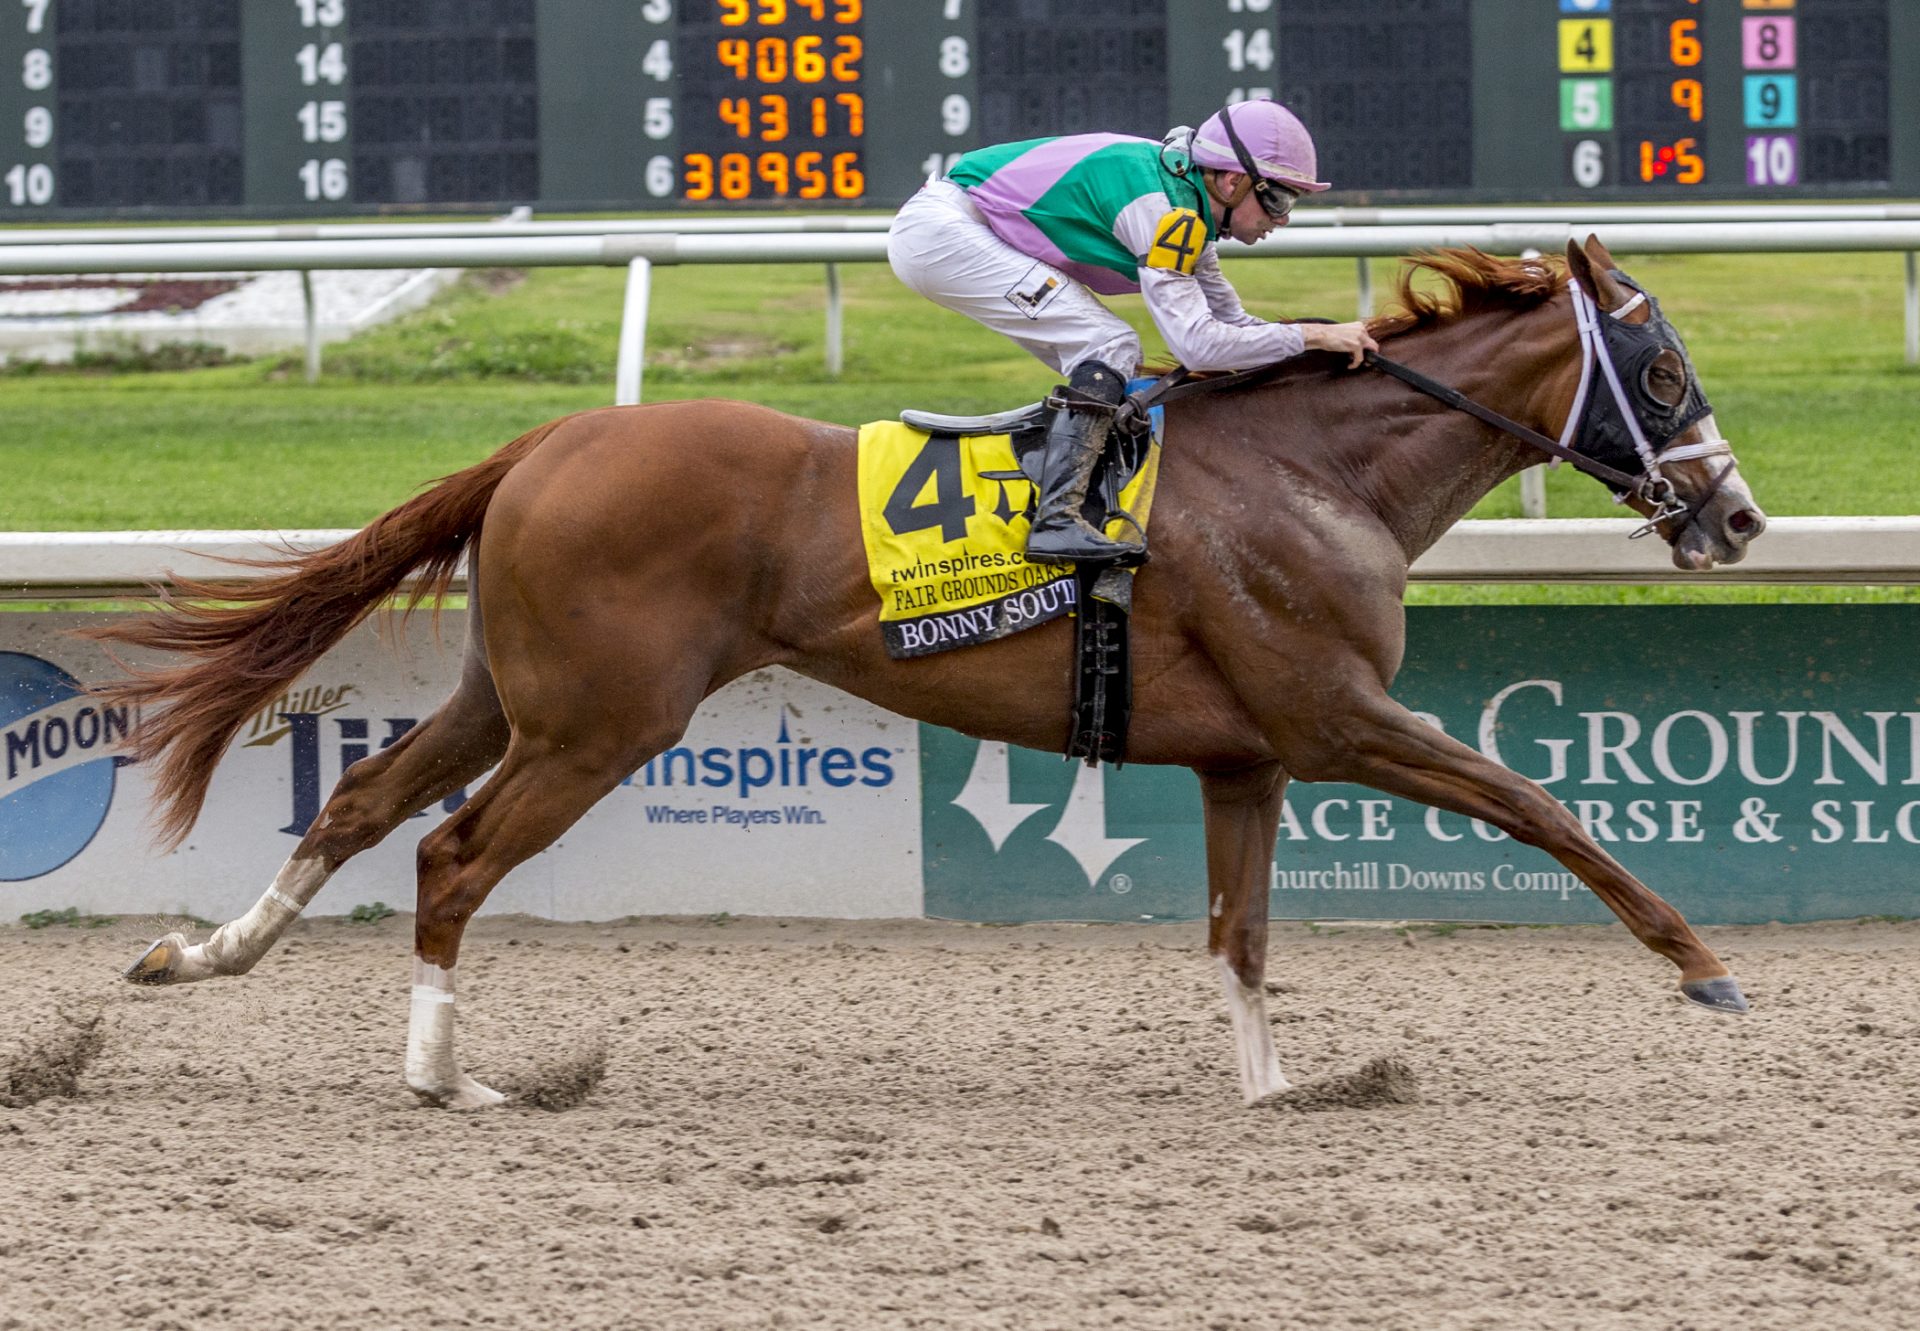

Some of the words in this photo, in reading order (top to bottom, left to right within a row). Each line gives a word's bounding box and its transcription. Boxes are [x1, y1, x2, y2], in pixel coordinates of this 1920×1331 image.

[643, 39, 673, 82] 4
[717, 35, 863, 83] 4062
[939, 35, 970, 79] 8
[1222, 28, 1275, 72] 14
[1574, 27, 1596, 64] 4
[1669, 18, 1702, 67] 6
[1758, 23, 1780, 61] 8
[23, 48, 52, 90] 8
[296, 43, 347, 85] 14
[298, 101, 347, 142] 15
[643, 97, 673, 139] 5
[719, 93, 864, 142] 4317
[942, 94, 971, 136] 9
[1573, 84, 1599, 127] 5
[1671, 79, 1703, 122] 9
[1760, 82, 1781, 119] 9
[24, 106, 53, 147] 9
[300, 159, 347, 200] 16
[645, 155, 674, 196] 6
[684, 152, 864, 199] 38956
[1572, 139, 1603, 187] 6
[1748, 137, 1784, 185] 10
[6, 165, 53, 205] 10
[1157, 215, 1196, 272] 4
[882, 432, 976, 543] 4
[891, 544, 1029, 582] twinspires.c
[894, 584, 938, 611] FAIR
[941, 571, 1018, 602] GROUNDS
[1023, 563, 1066, 587] OAKS
[898, 605, 995, 649] BONNY
[249, 683, 356, 738] Miller
[5, 703, 128, 780] MOON
[645, 805, 707, 825] Where
[712, 805, 781, 829] Players
[783, 805, 826, 825] Win.
[1277, 799, 1395, 841] ACE
[1425, 799, 1705, 842] CRSE
[1733, 797, 1783, 843] &
[1271, 861, 1379, 889] hurchill
[1387, 863, 1485, 890] Downs
